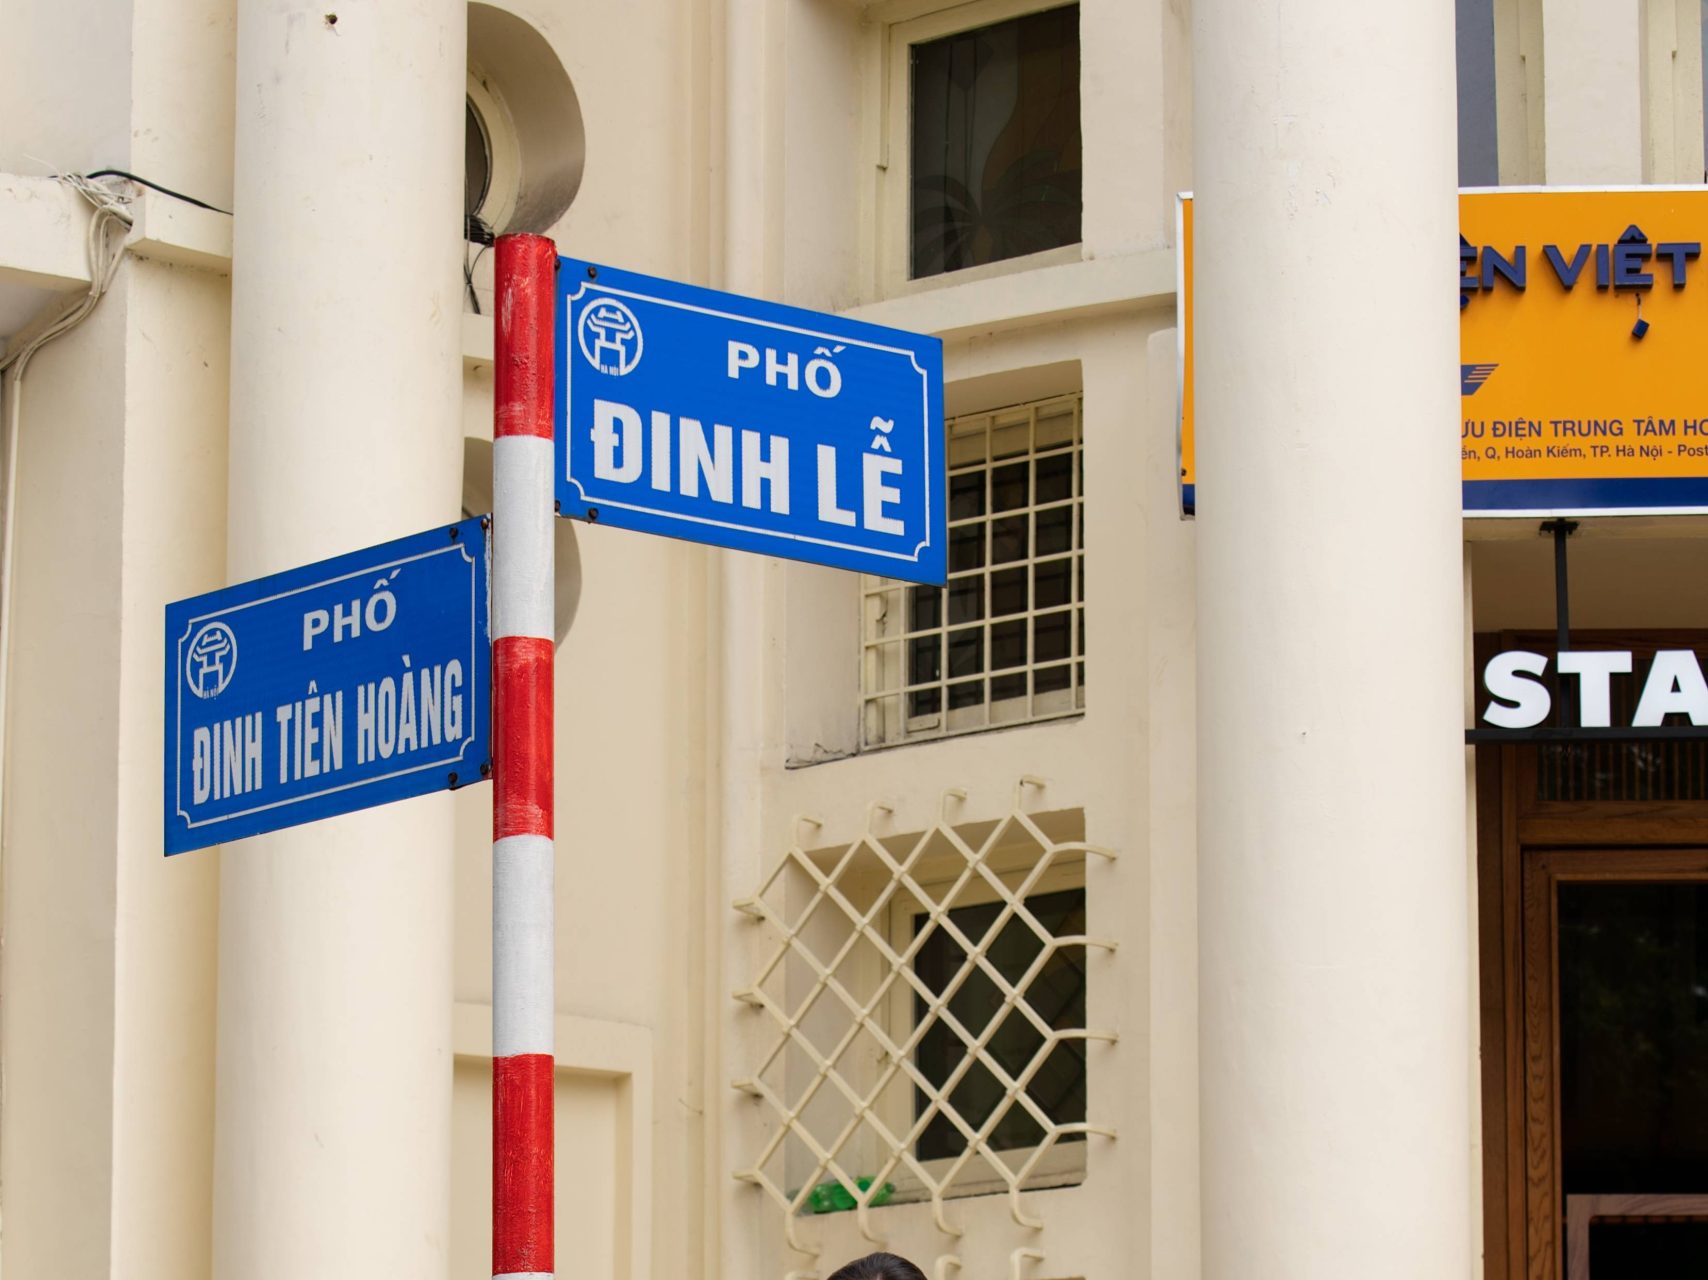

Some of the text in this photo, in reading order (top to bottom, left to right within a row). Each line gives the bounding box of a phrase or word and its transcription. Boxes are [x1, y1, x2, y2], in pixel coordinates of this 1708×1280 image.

[728, 340, 846, 398] PHỐ
[590, 398, 905, 536] ĐINH LỄ
[1492, 417, 1541, 441] ĐIỆN
[1549, 419, 1623, 438] TRUNG
[1633, 416, 1676, 436] TÂM
[1505, 446, 1541, 459] Hoàn
[1547, 443, 1586, 459] Kiếm,
[1590, 445, 1611, 458] TP.
[1616, 444, 1635, 458] Hà
[1639, 444, 1662, 461] Nội
[303, 568, 401, 651] PHỐ
[1482, 650, 1708, 729] STA
[192, 654, 463, 805] ĐINH TIÊN HOÀNG
